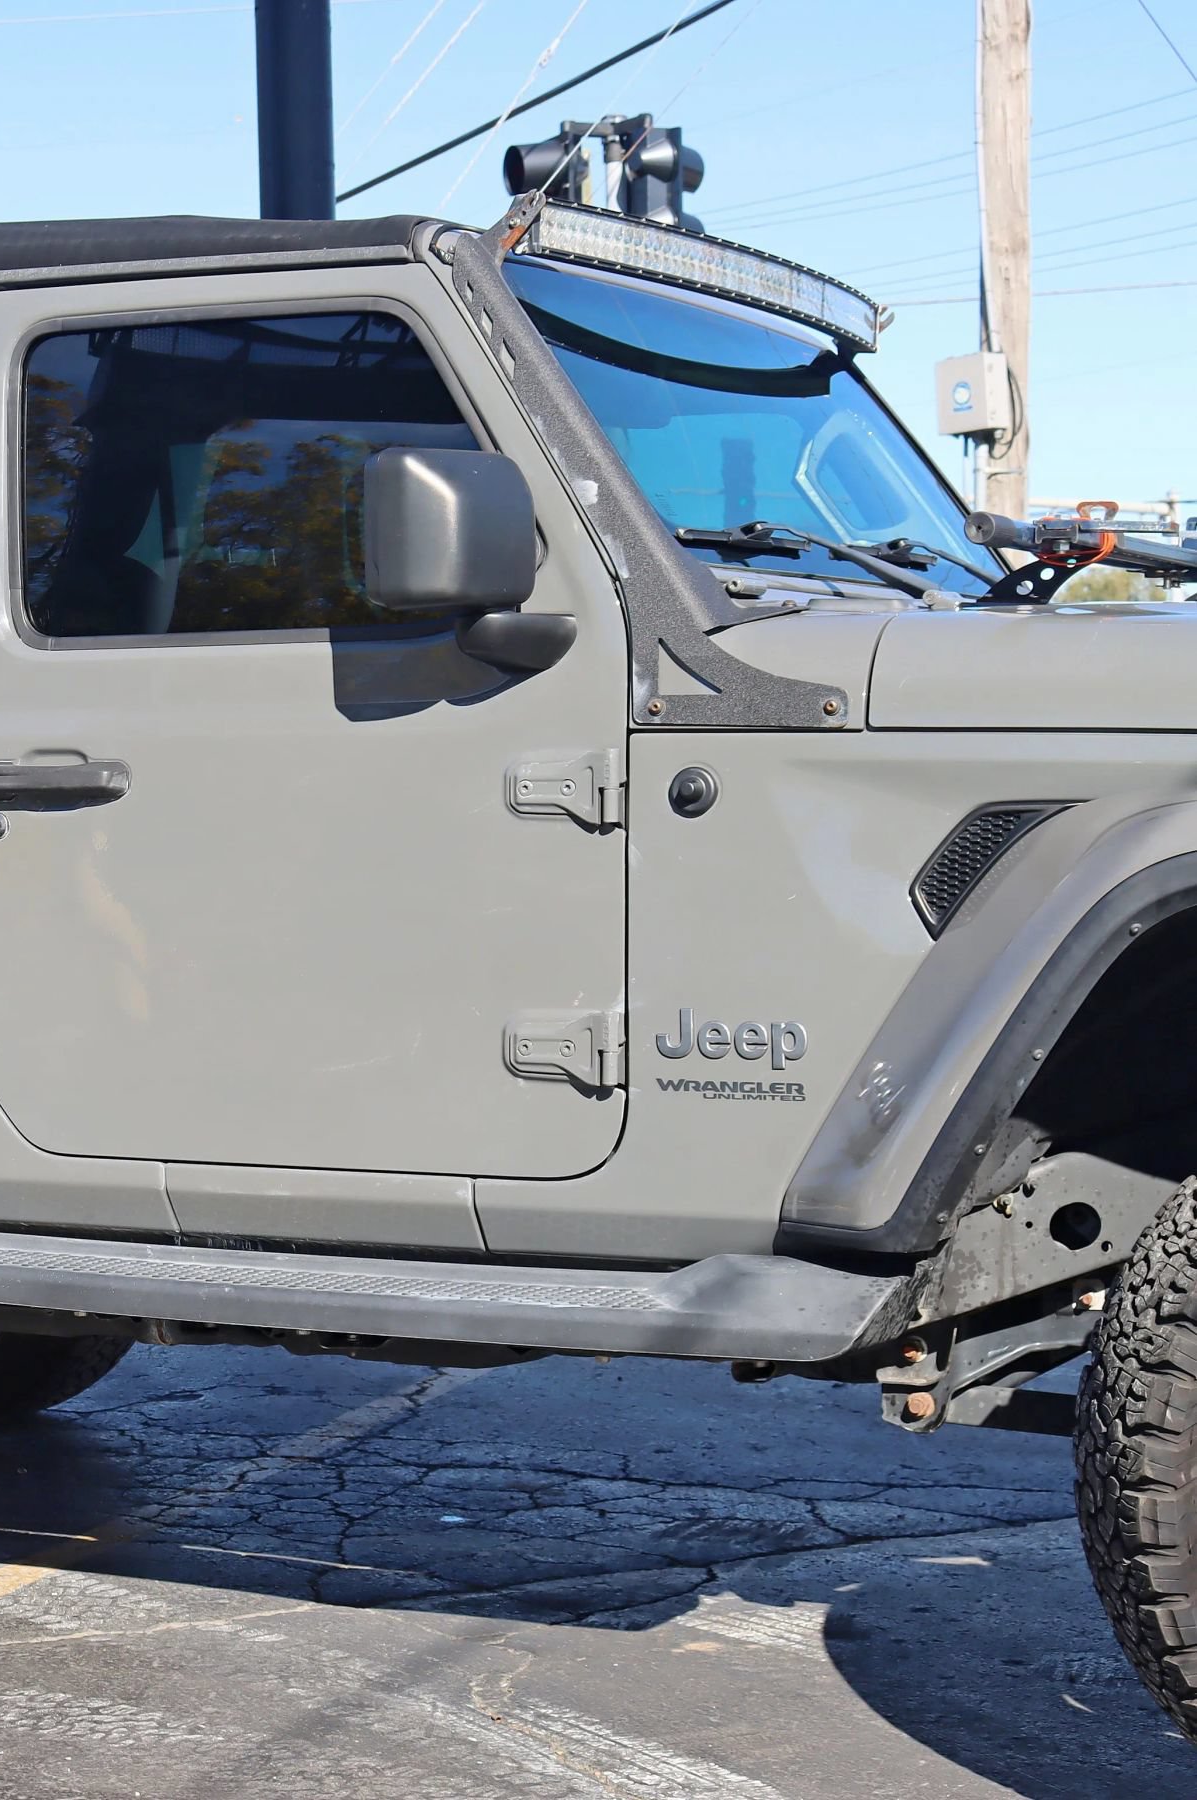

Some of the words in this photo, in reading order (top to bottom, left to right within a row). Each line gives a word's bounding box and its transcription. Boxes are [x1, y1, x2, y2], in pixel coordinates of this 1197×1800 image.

[655, 1007, 808, 1071] Jeep
[656, 1078, 806, 1095] WRANGLER
[702, 1093, 806, 1102] UNLIMITED
